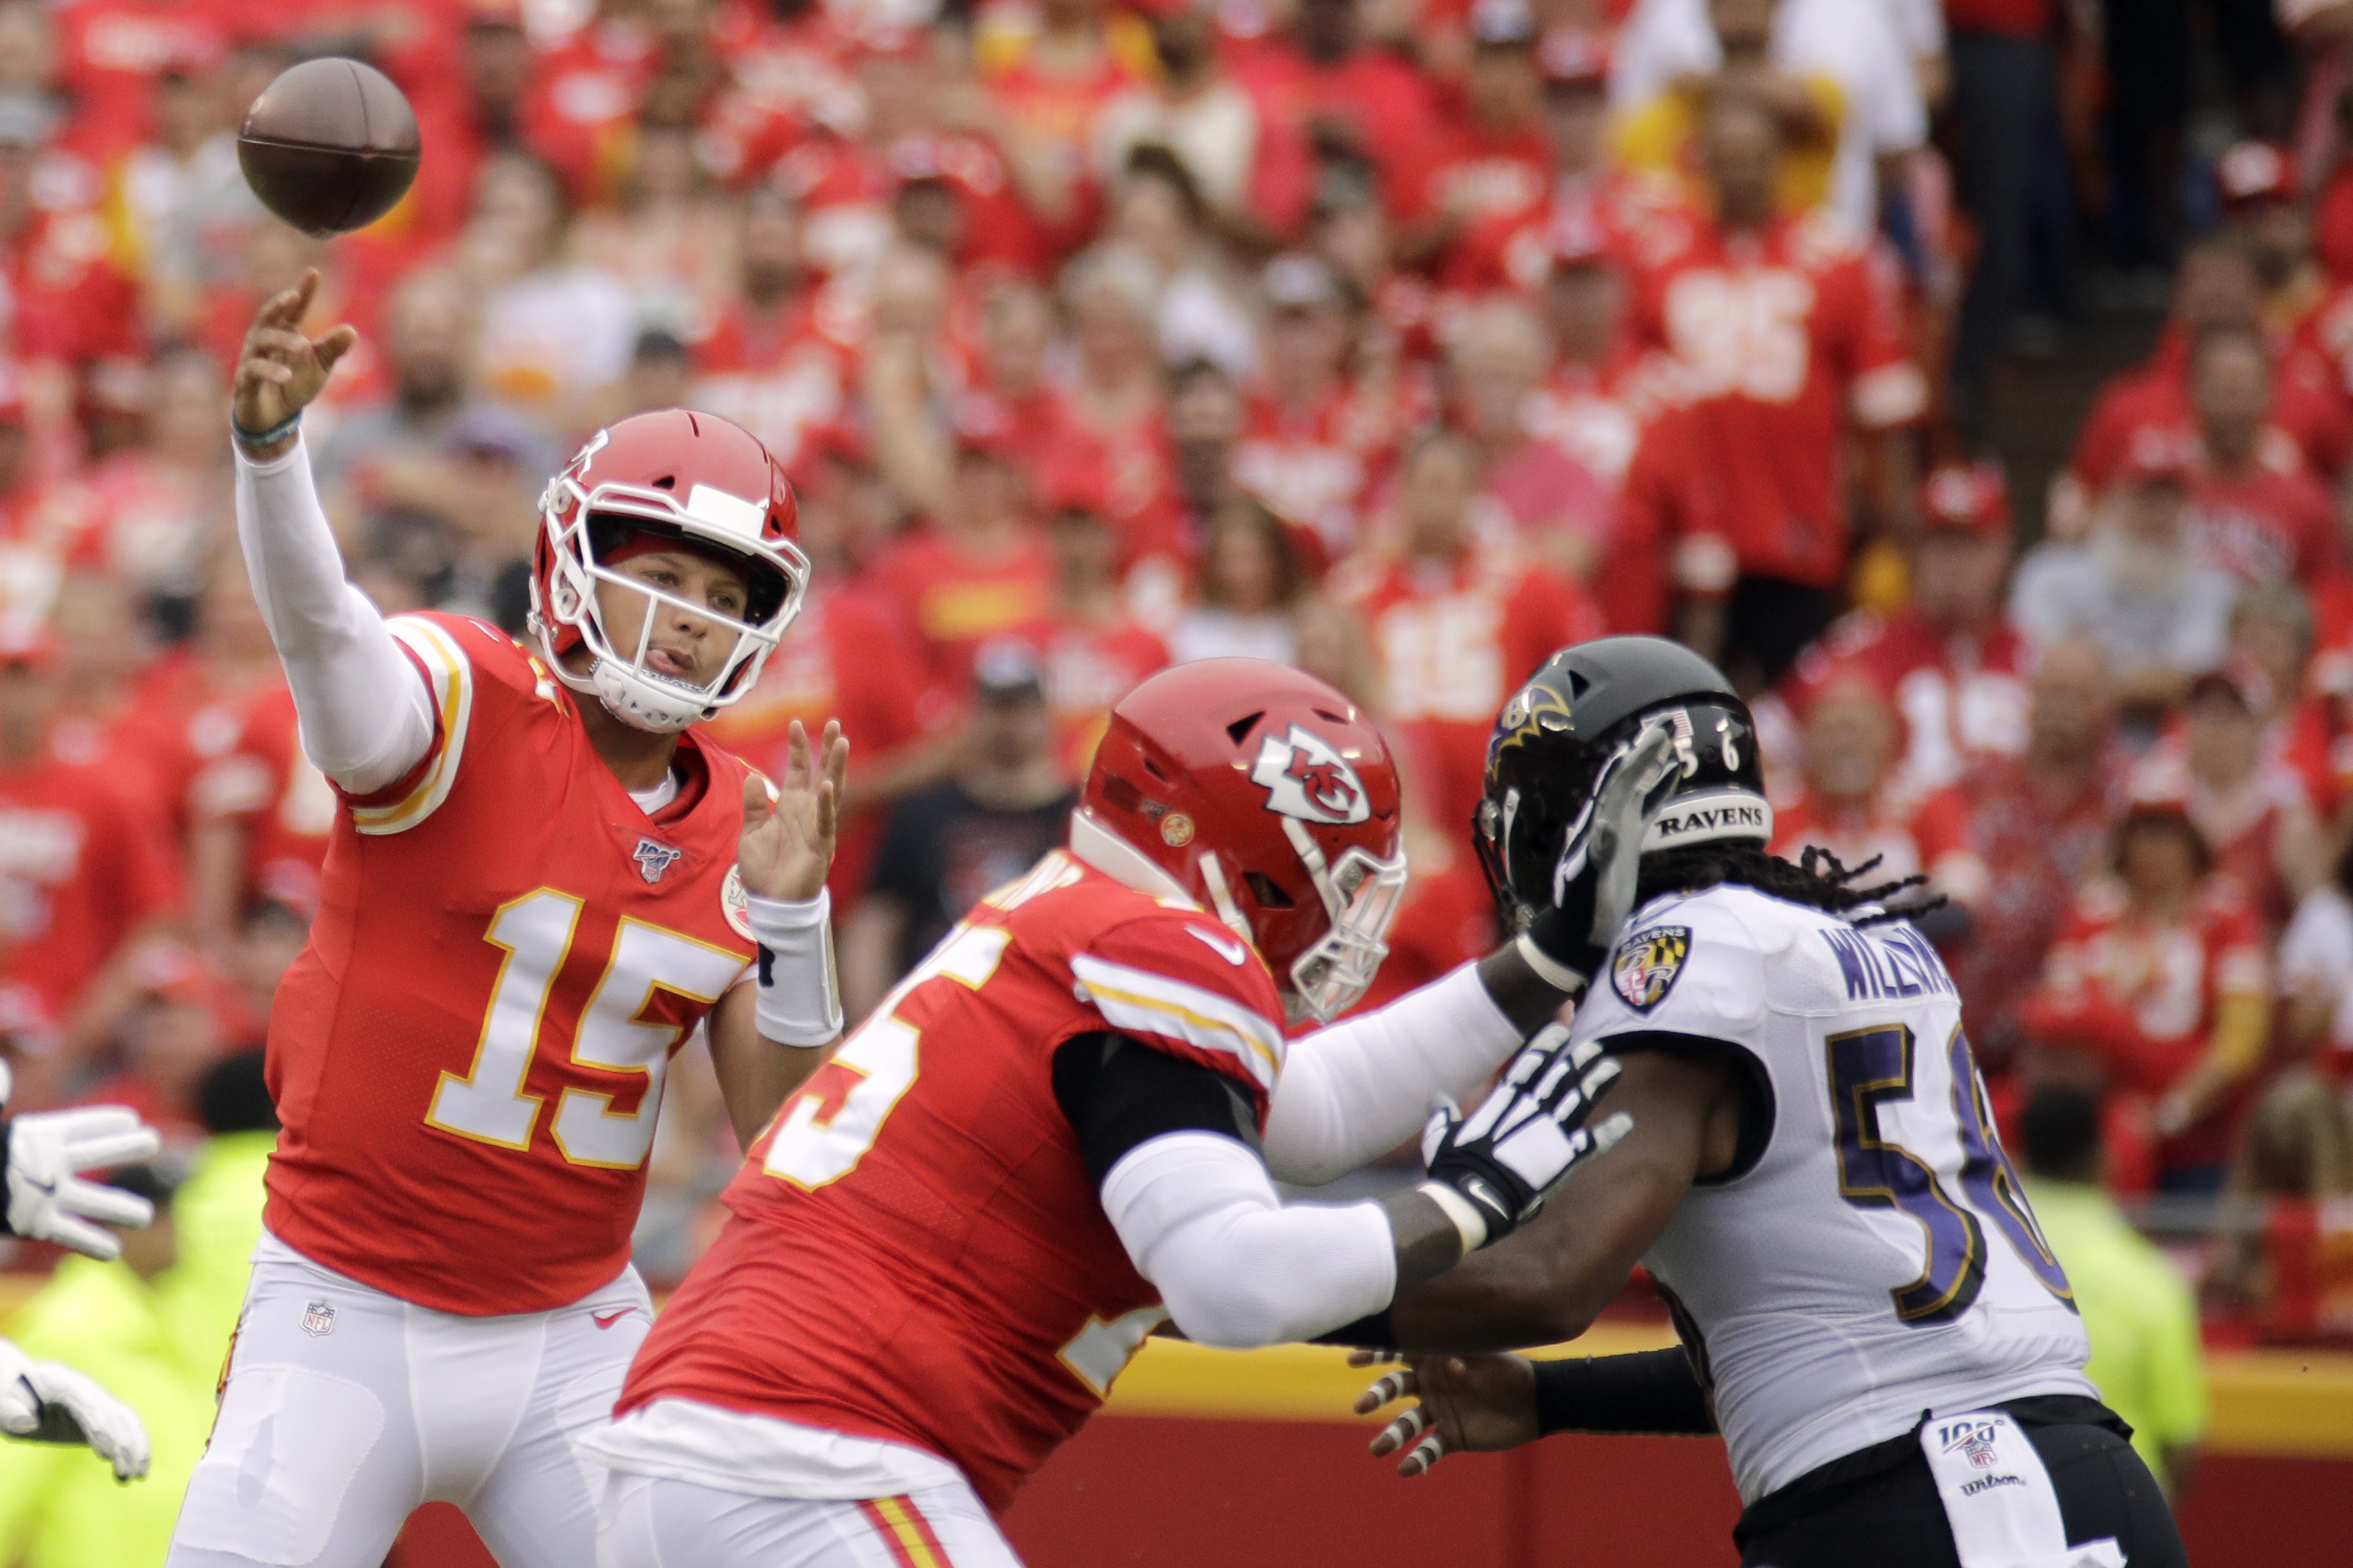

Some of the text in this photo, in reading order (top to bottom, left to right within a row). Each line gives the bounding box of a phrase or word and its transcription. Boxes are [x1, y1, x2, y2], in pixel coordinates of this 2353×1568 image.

[1654, 806, 1763, 838] RAVENS
[423, 886, 752, 1171] 15
[305, 1313, 329, 1331] NFL
[1971, 1450, 1998, 1466] NFL
